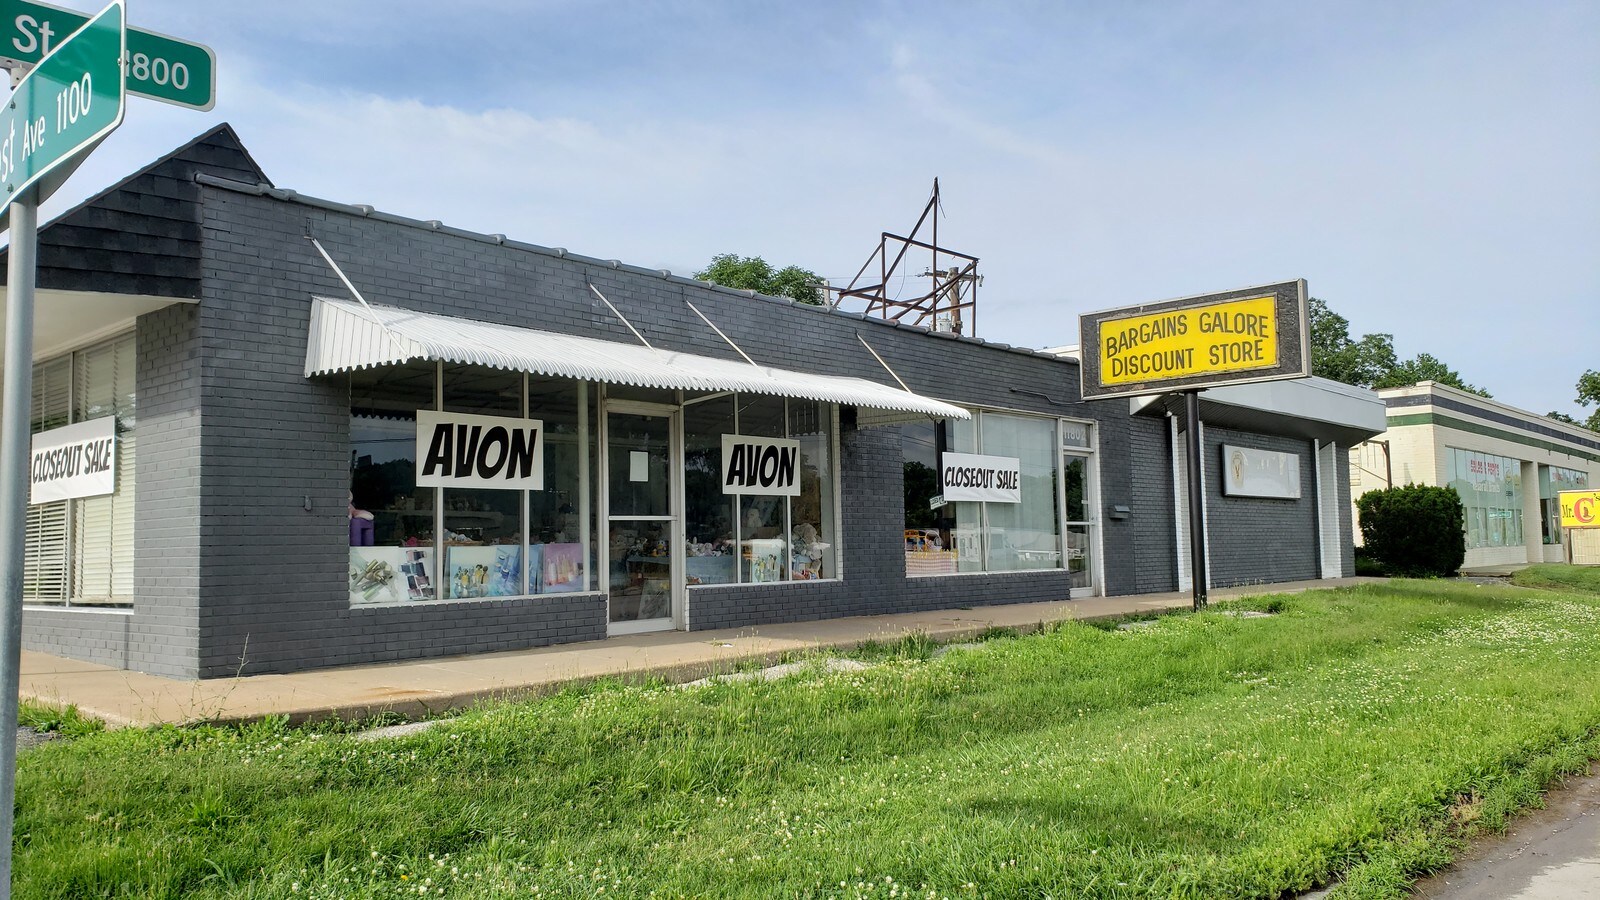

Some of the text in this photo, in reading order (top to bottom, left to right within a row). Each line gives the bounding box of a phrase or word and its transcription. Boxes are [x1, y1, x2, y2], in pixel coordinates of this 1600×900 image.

[12, 14, 54, 56] St
[0, 72, 92, 183] st Ave 1100
[1106, 311, 1269, 359] BARGAINS GALORE
[1112, 339, 1264, 377] DISCOUNT STORE
[32, 438, 112, 484] CLOSEOUT SALE
[421, 422, 538, 480] AVON
[725, 443, 797, 488] AVON
[944, 466, 1018, 490] CLOSEOUT SALE
[1561, 504, 1575, 518] Mr.
